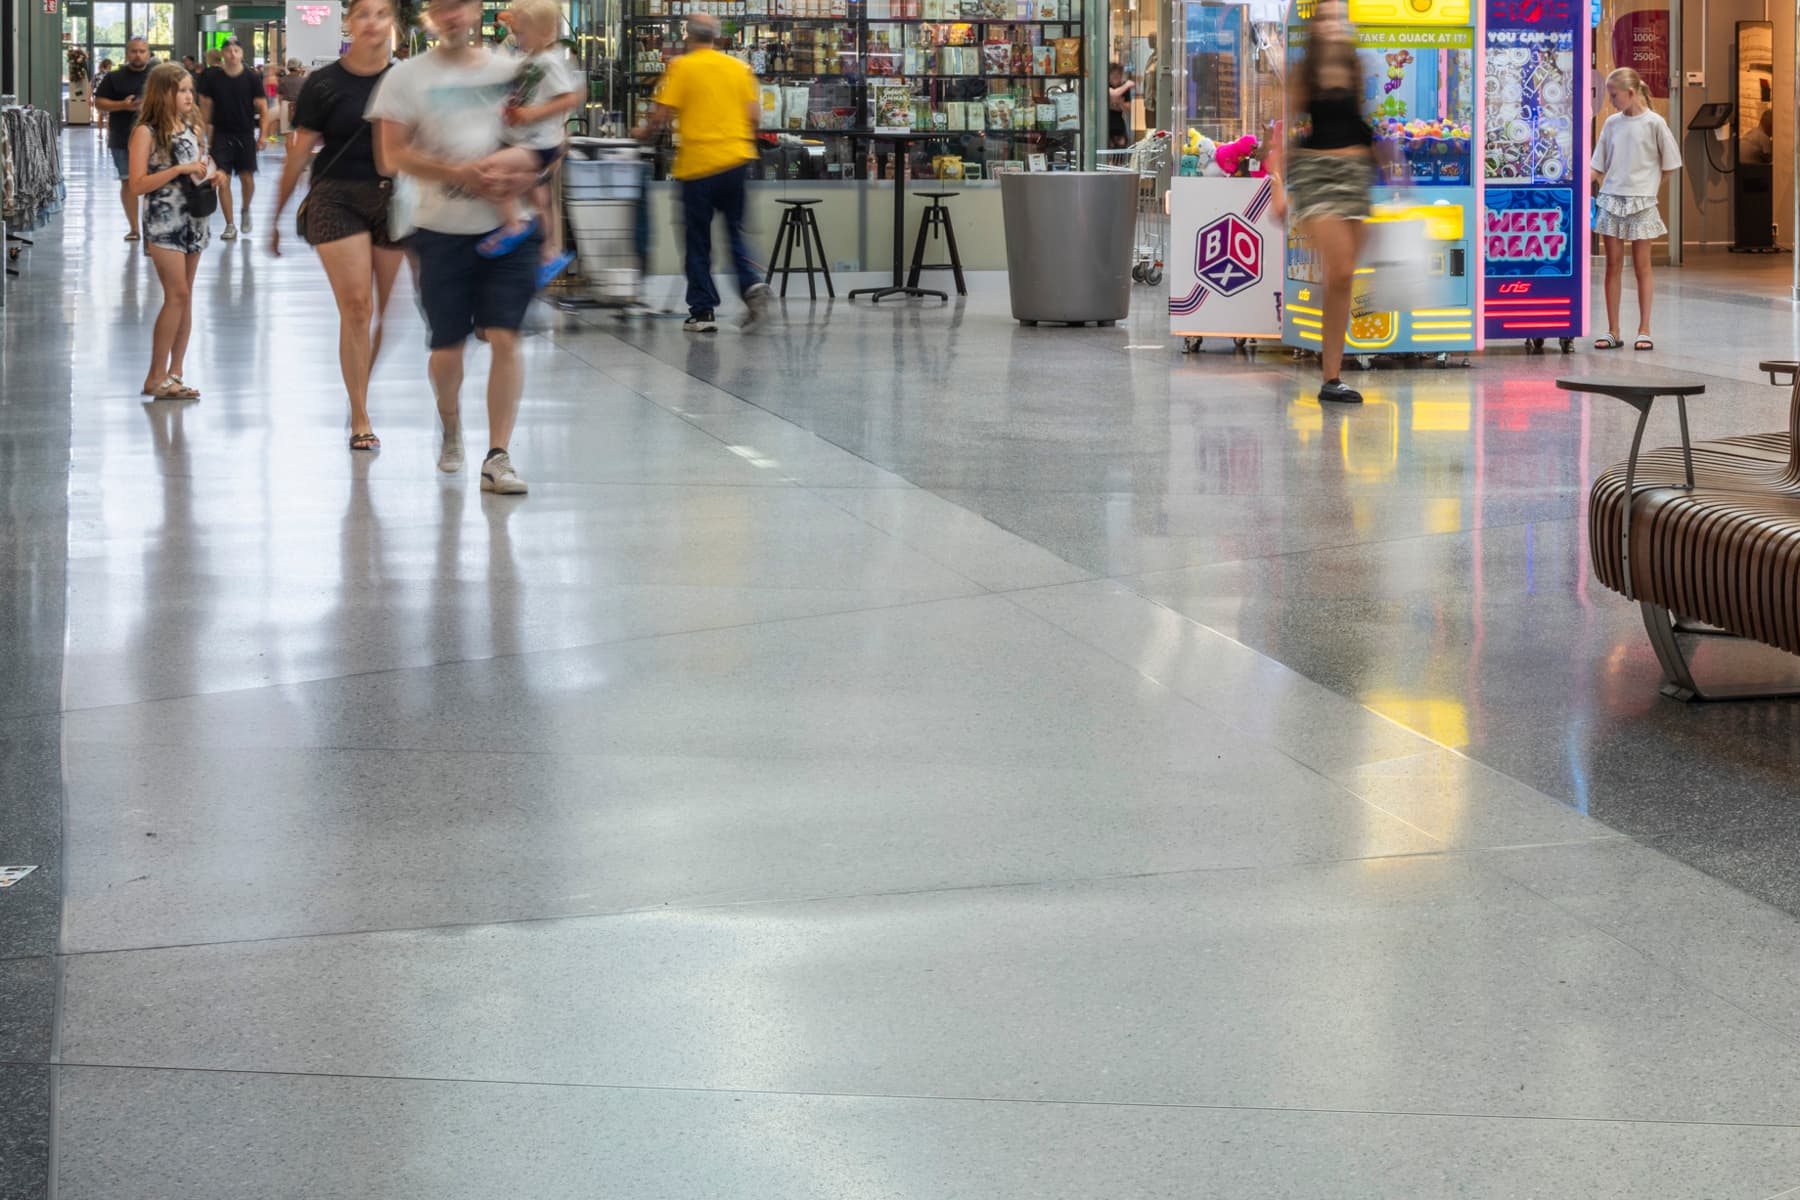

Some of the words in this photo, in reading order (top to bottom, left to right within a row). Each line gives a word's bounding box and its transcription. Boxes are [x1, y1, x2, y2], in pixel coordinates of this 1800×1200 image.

[1358, 32, 1387, 43] TAKE
[1387, 32, 1396, 43] A
[1398, 32, 1436, 43] QUACK
[1437, 33, 1451, 43] AT
[1453, 33, 1468, 43] IT!
[1487, 31, 1516, 43] YOU
